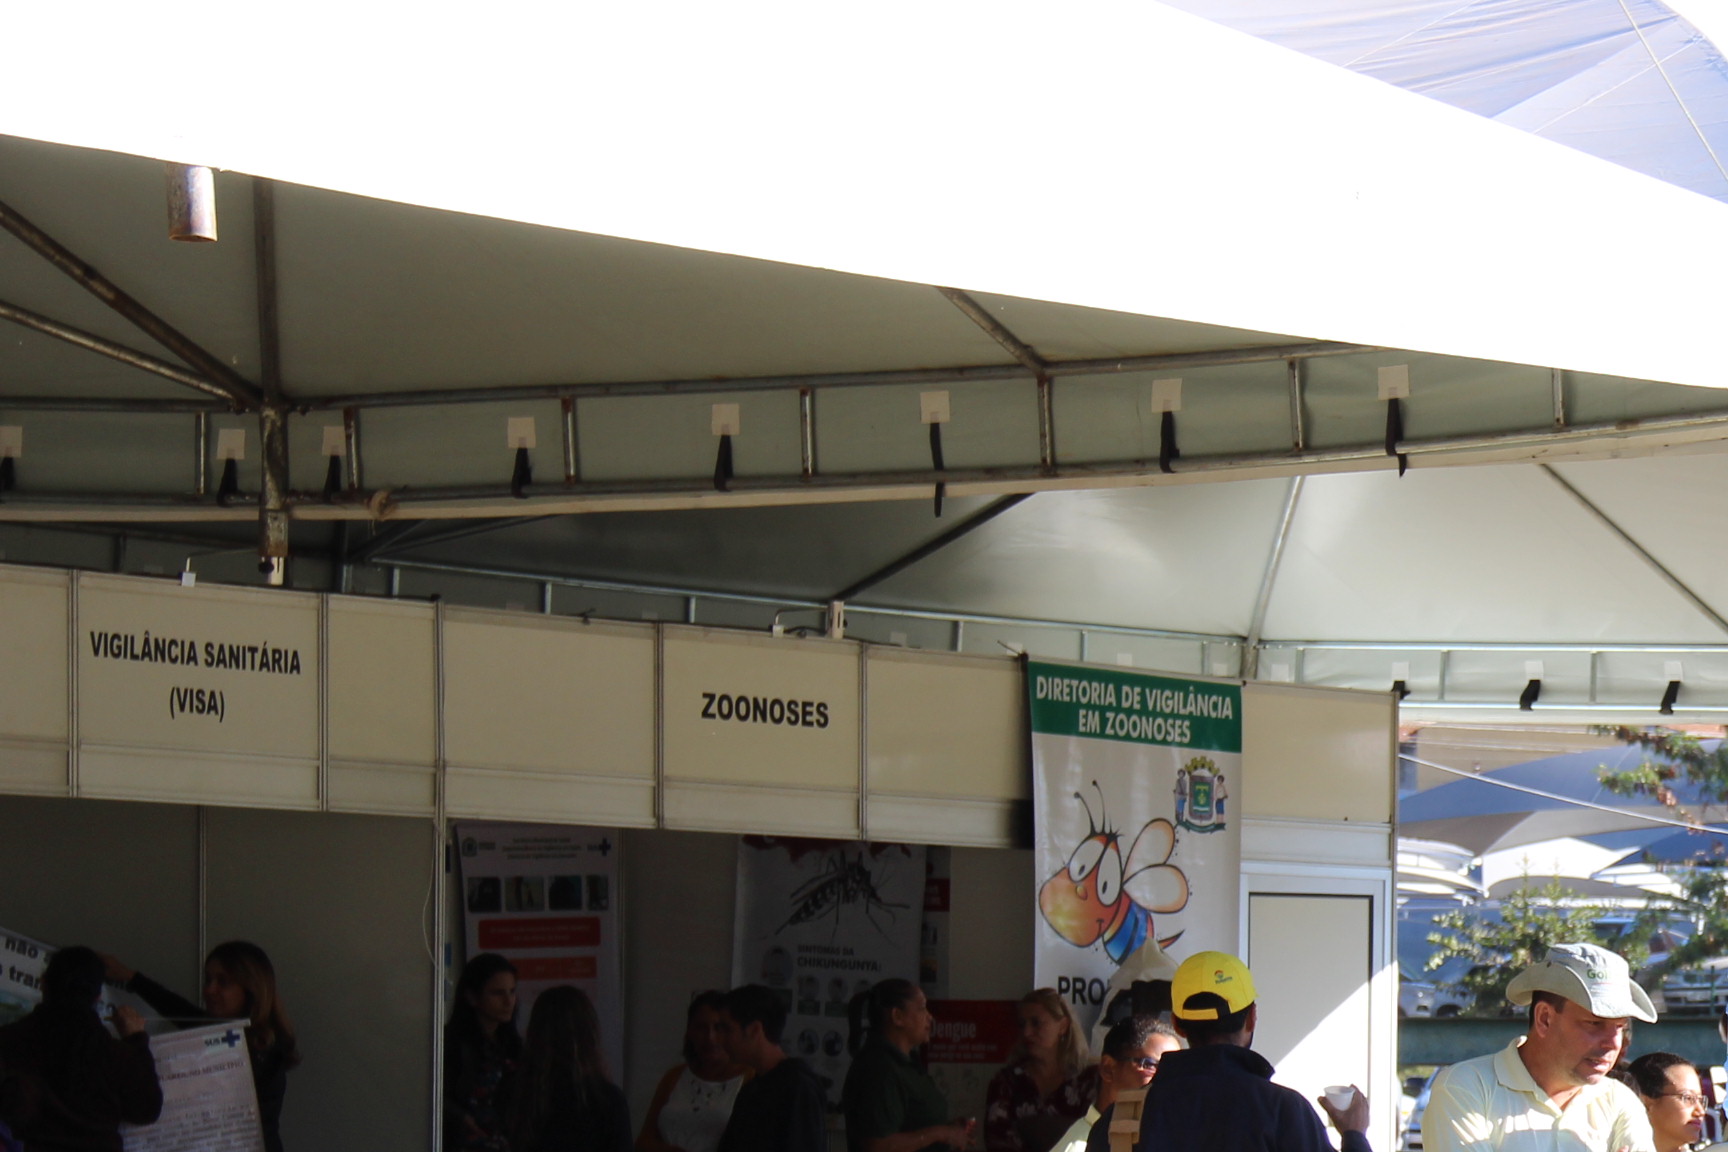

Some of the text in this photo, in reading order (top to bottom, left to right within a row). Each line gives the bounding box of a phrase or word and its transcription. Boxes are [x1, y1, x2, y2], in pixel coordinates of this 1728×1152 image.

[90, 629, 302, 676] VIGILÂNCIA SANITÁRIA
[168, 685, 226, 723] (VISA)
[701, 692, 830, 729] ZOONOSES
[1036, 675, 1233, 721] DIRETORIA DE VIGILÂNCIA
[1078, 709, 1192, 744] EM ZOONOSES
[1057, 976, 1106, 1006] PRO
